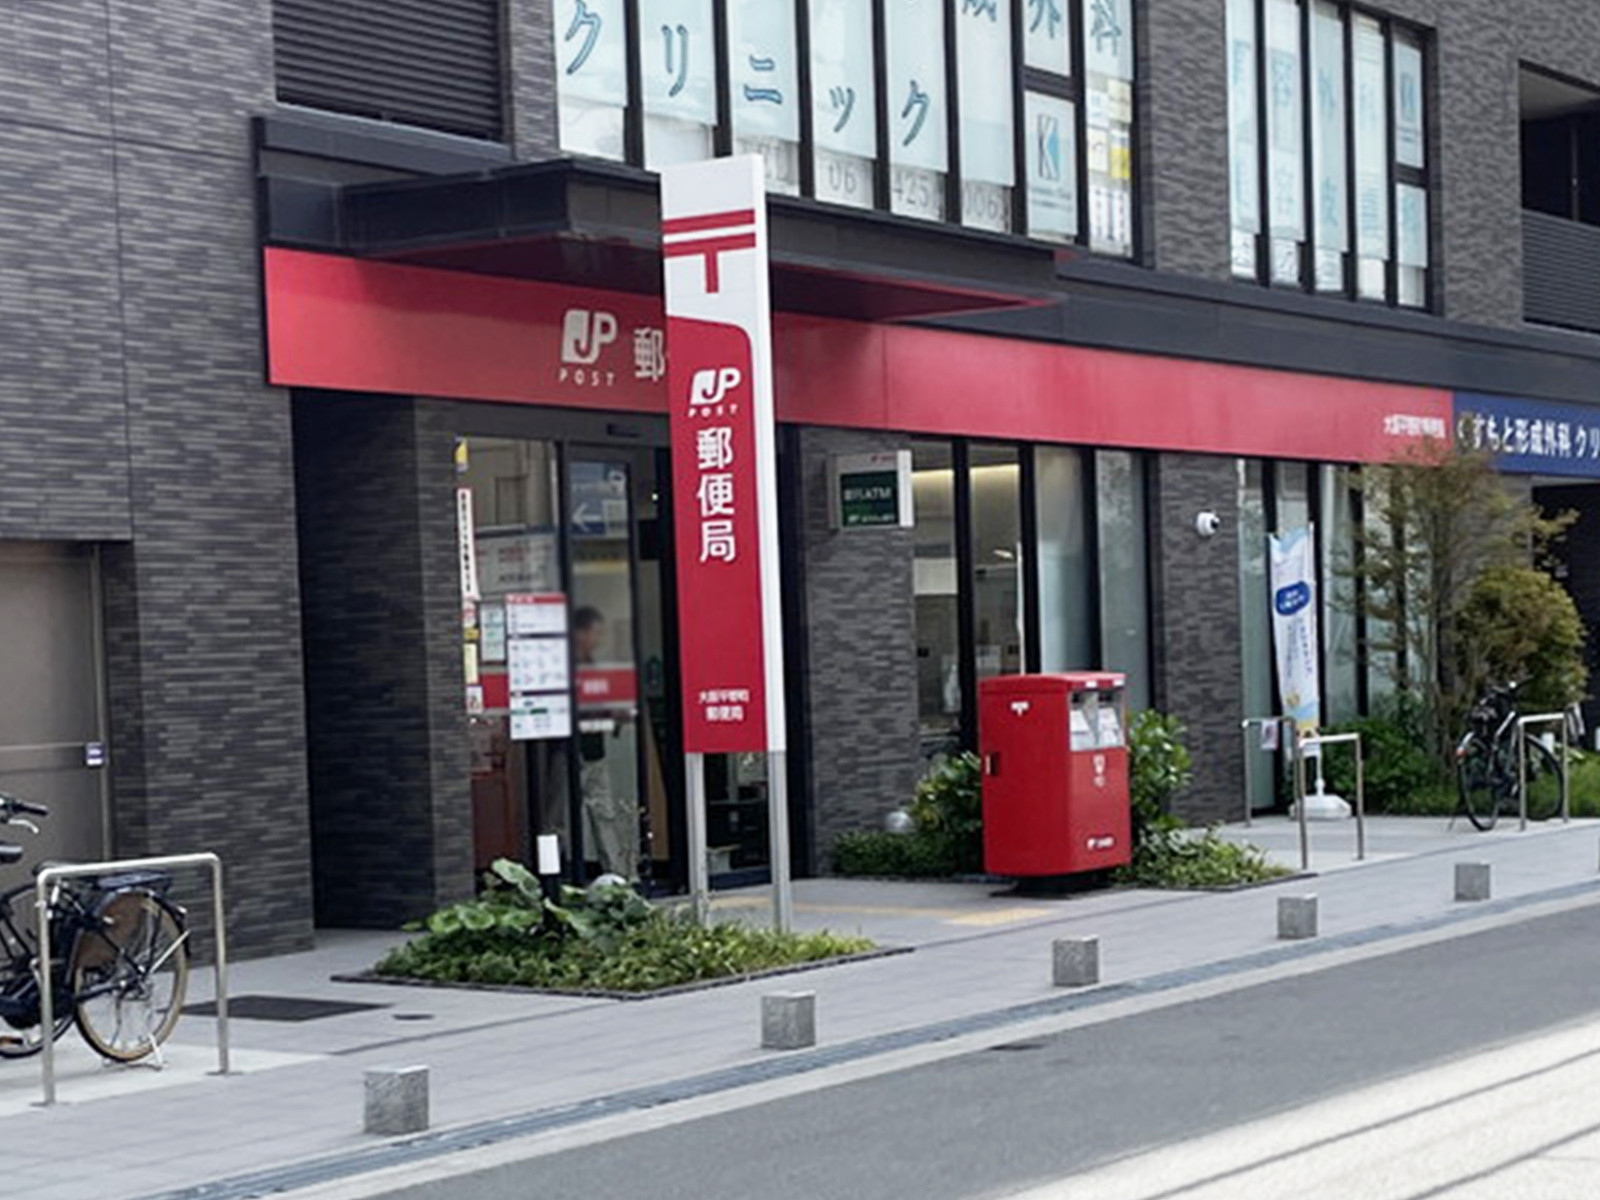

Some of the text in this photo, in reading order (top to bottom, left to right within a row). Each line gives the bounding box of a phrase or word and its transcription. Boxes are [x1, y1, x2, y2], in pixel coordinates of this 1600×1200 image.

[564, 0, 930, 147] クリニック
[562, 309, 617, 364] JP
[559, 368, 616, 387] POST
[690, 367, 740, 405] JP
[688, 404, 738, 417] POST
[697, 427, 735, 563] 郵便局
